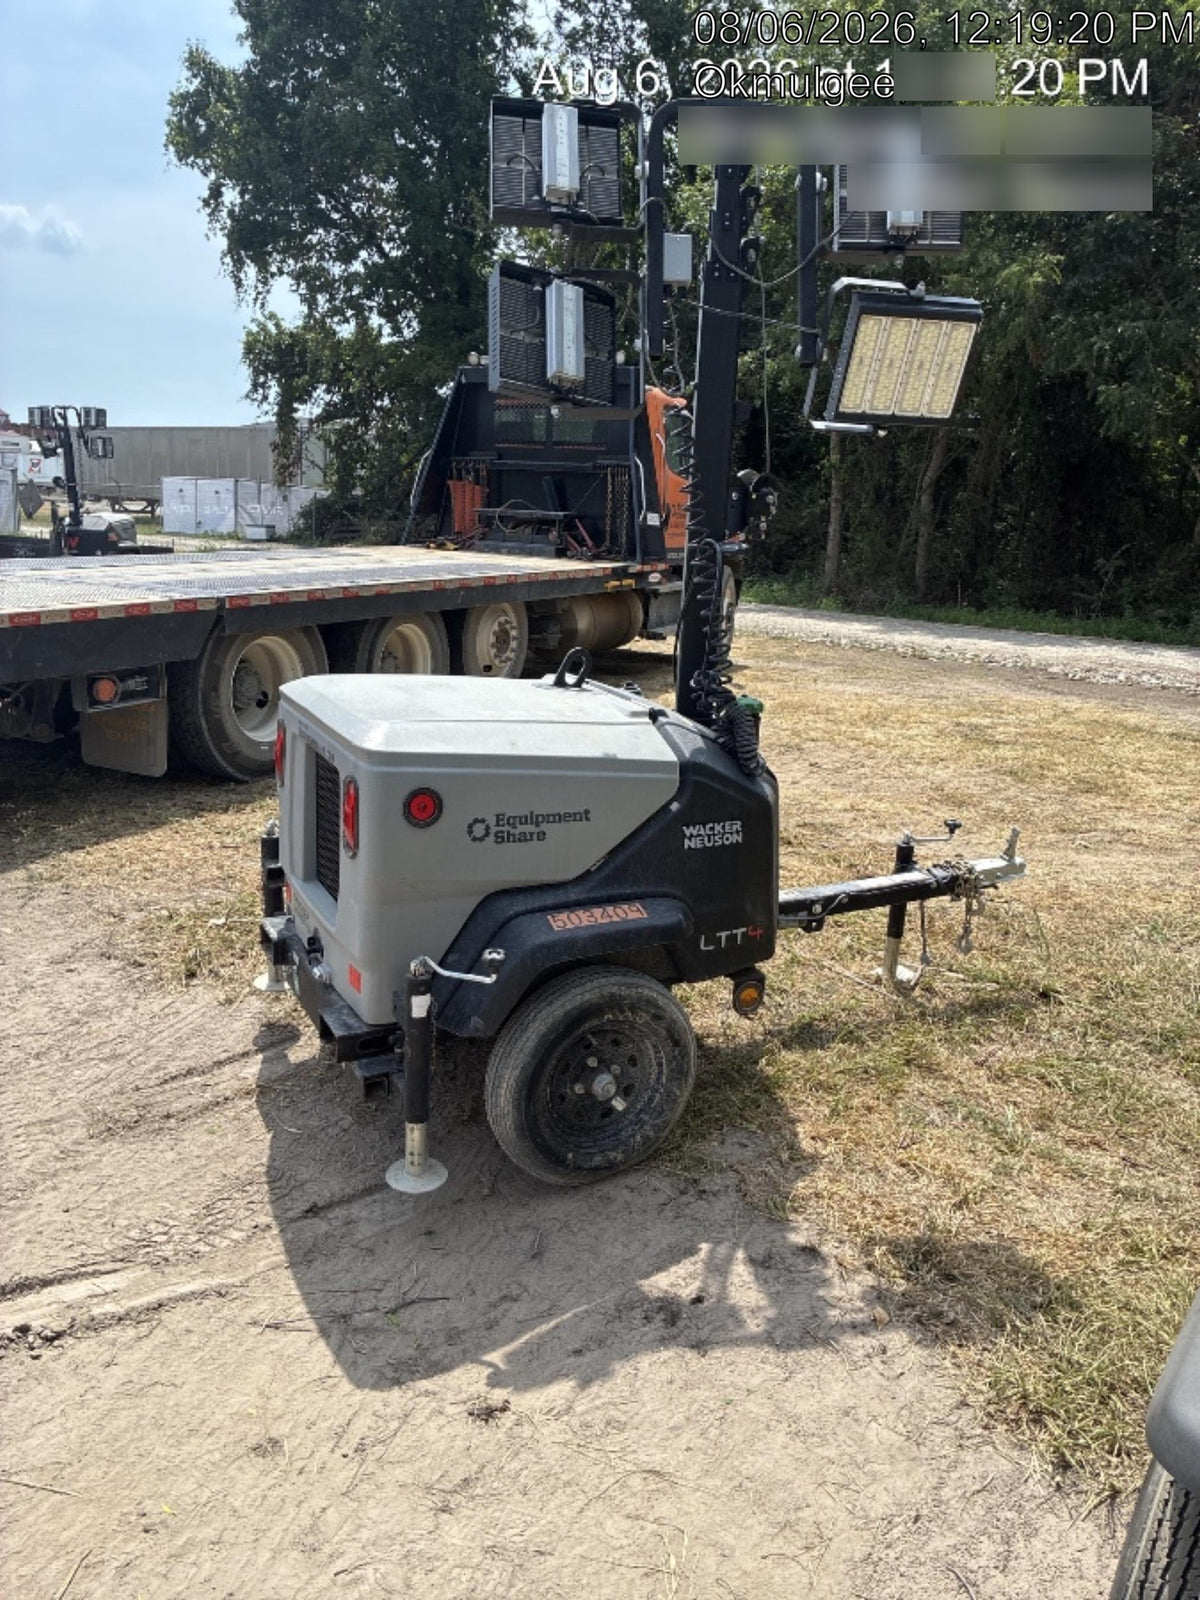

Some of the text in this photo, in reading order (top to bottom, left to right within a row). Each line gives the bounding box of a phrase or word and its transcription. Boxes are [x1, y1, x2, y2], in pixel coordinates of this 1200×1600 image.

[494, 808, 591, 829] Equipment
[494, 829, 547, 845] Share
[682, 820, 742, 837] WACKER
[684, 832, 742, 850] NEUSON
[551, 904, 644, 930] 503409
[700, 926, 763, 950] LTT4
